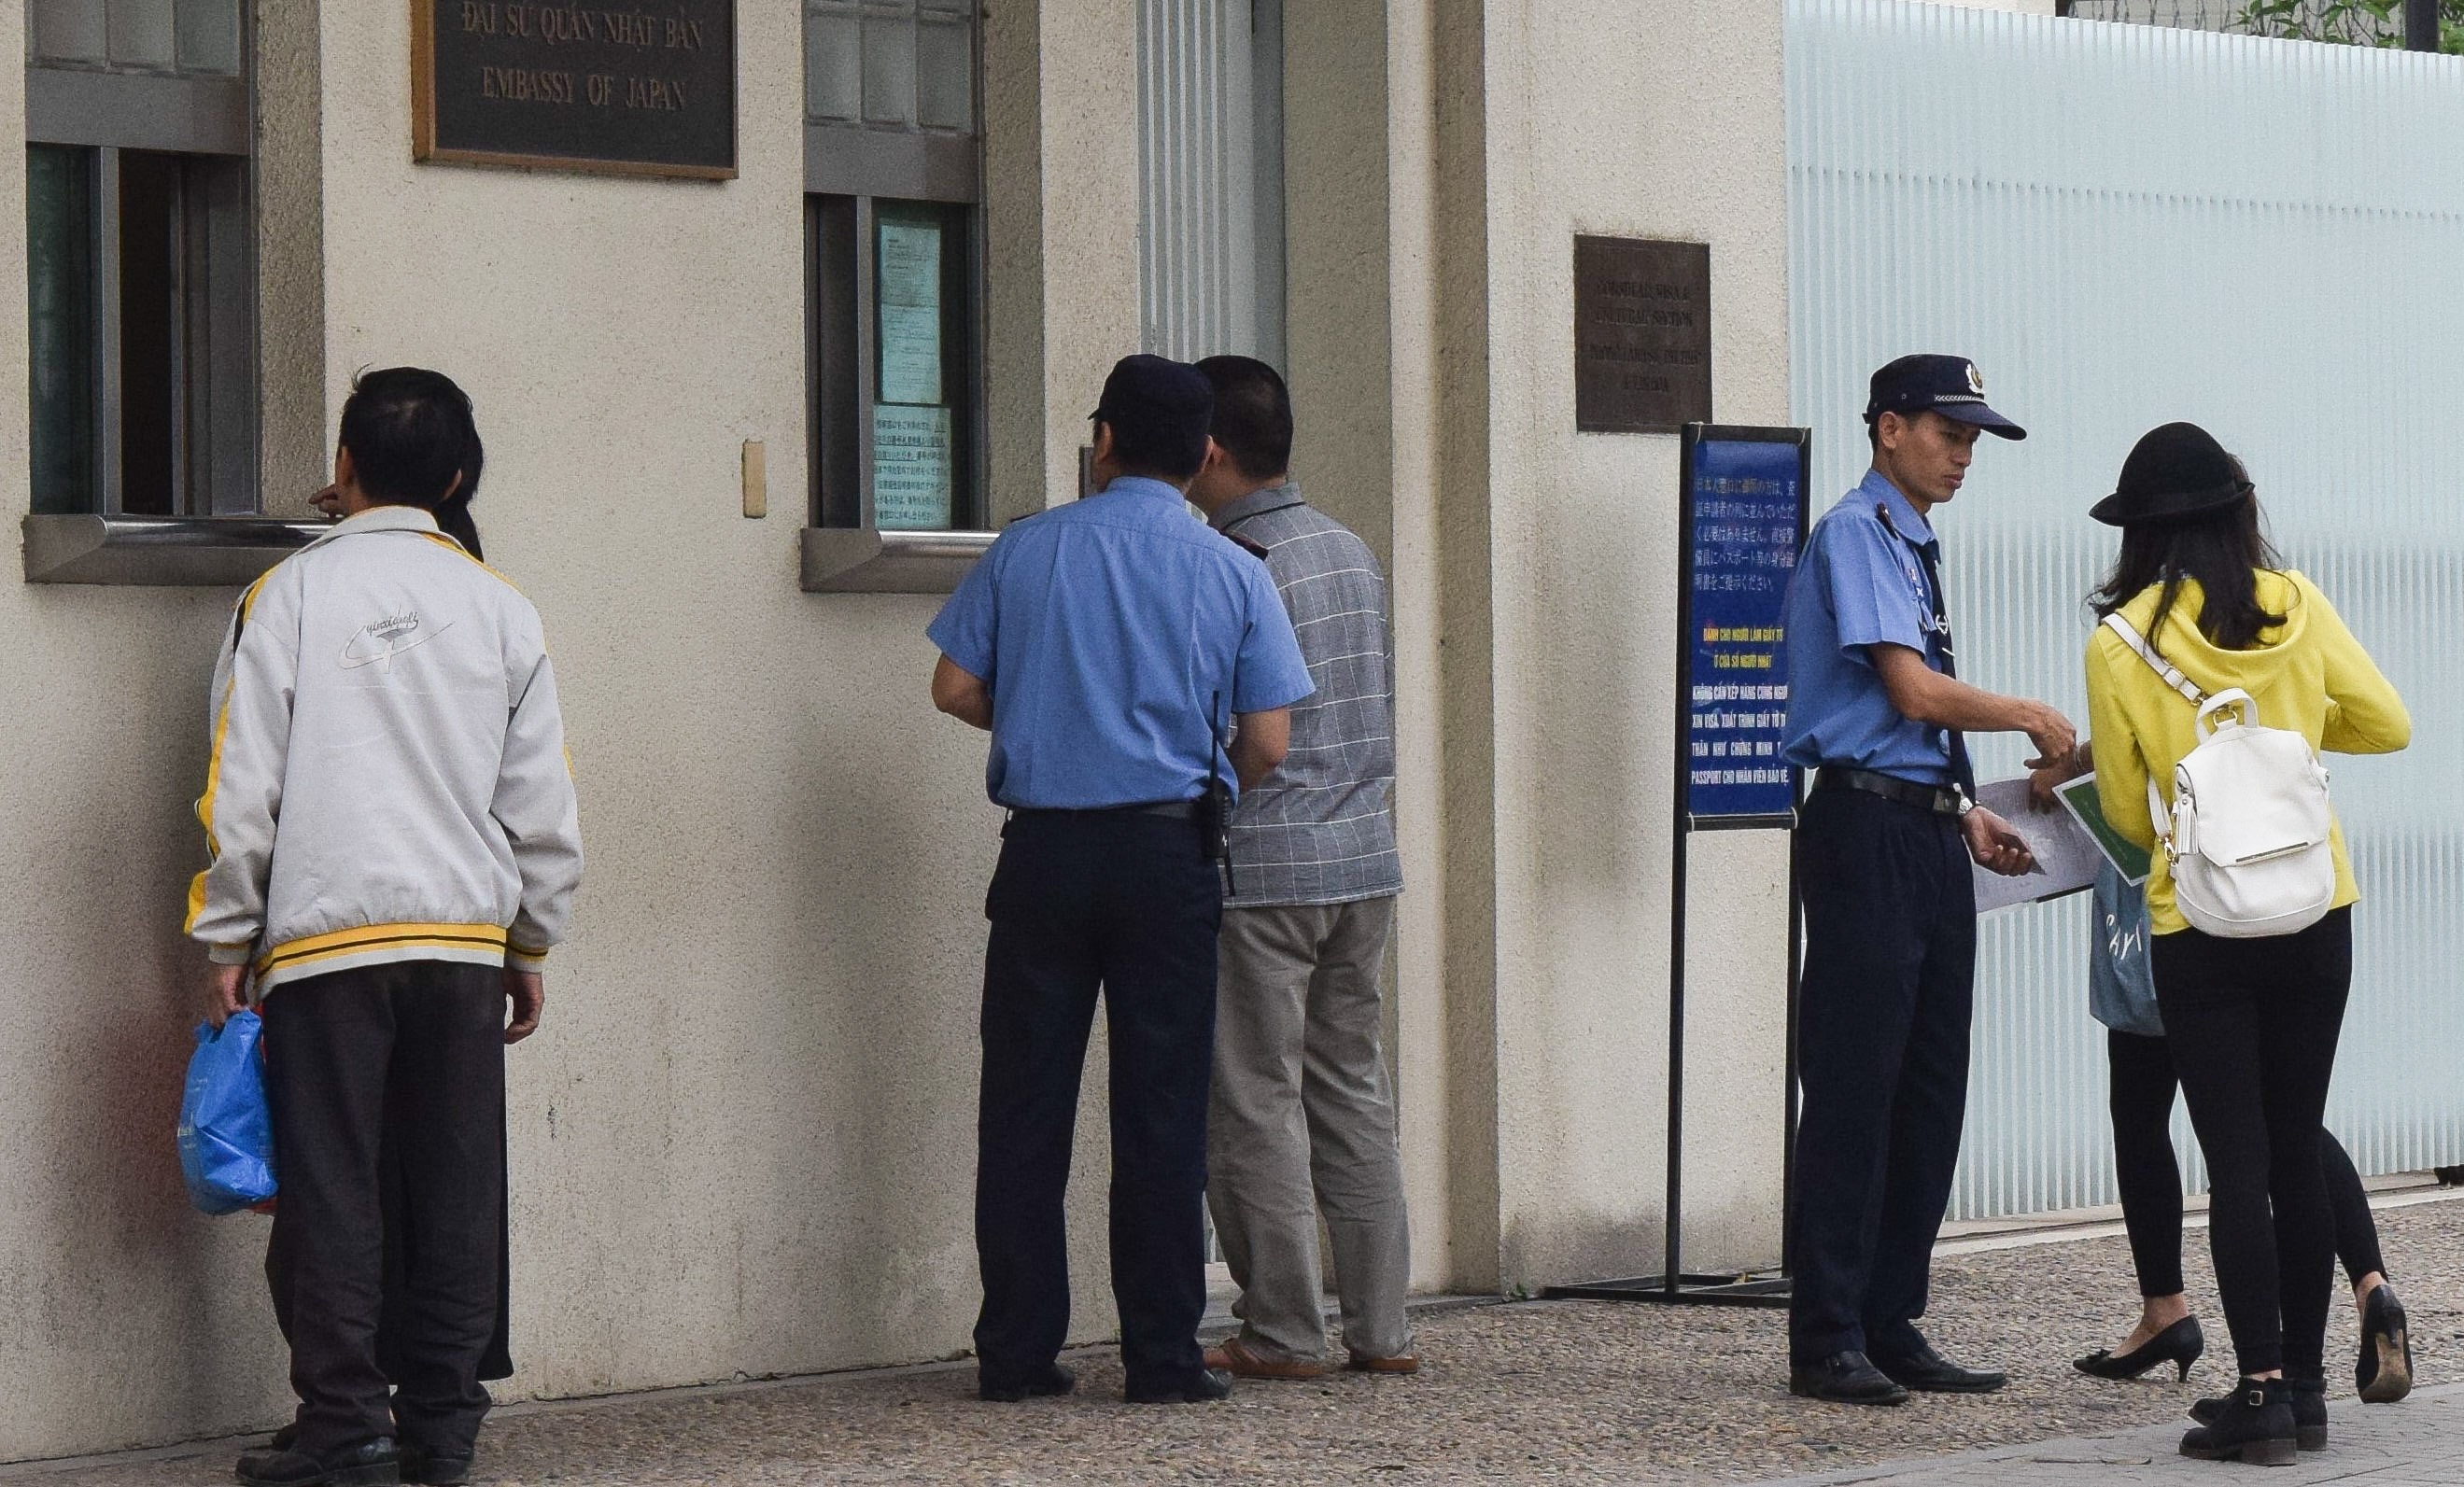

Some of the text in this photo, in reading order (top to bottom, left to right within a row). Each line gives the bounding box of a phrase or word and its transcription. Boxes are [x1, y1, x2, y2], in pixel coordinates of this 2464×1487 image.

[602, 7, 657, 52] NHẬT
[664, 6, 703, 49] BẢN
[481, 65, 688, 111] EMBASSY OF JAPAN
[1691, 769, 1722, 784] PASSPORT
[1723, 770, 1735, 784] CHO
